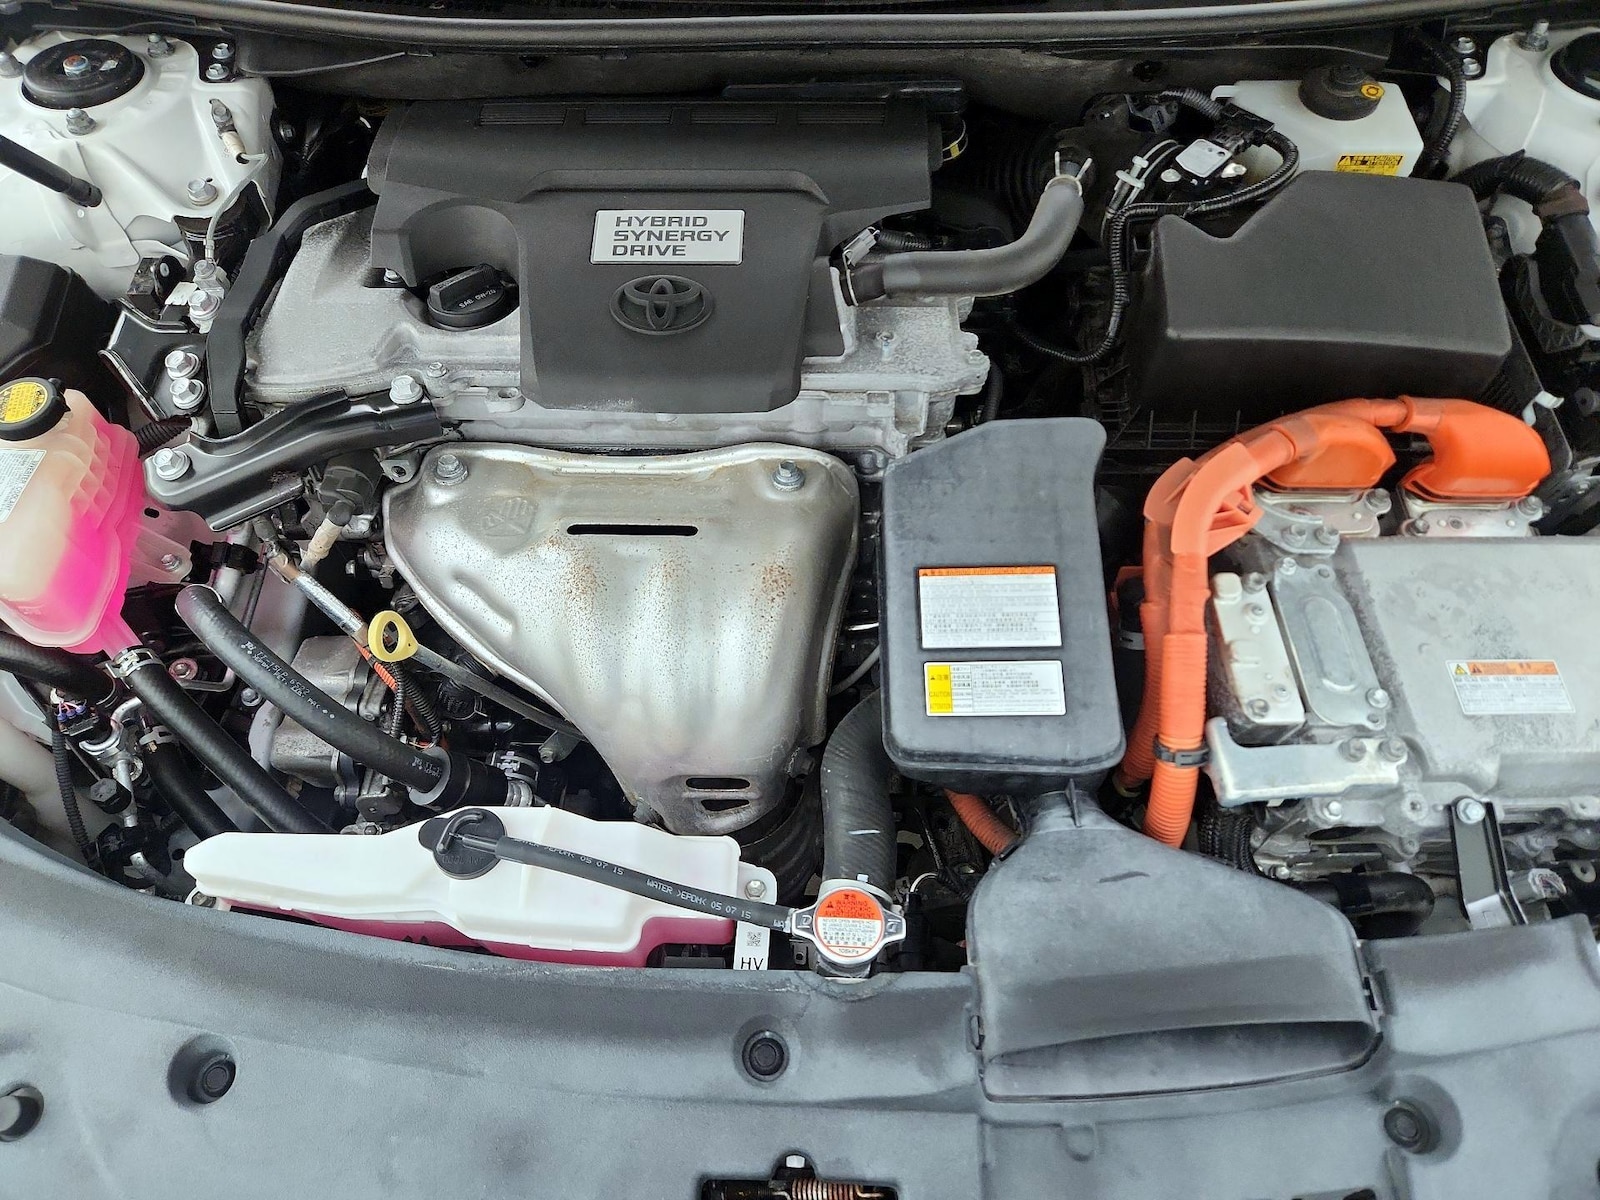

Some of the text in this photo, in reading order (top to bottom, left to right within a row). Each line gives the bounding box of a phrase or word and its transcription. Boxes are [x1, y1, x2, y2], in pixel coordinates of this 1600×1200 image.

[615, 216, 708, 227] HYBRID
[613, 230, 730, 242] SYNERGY
[612, 244, 687, 256] DRIVE
[596, 860, 608, 870] 07
[646, 878, 673, 895] WATER
[710, 901, 722, 911] 05
[725, 905, 738, 914] 07
[741, 957, 764, 970] HV
